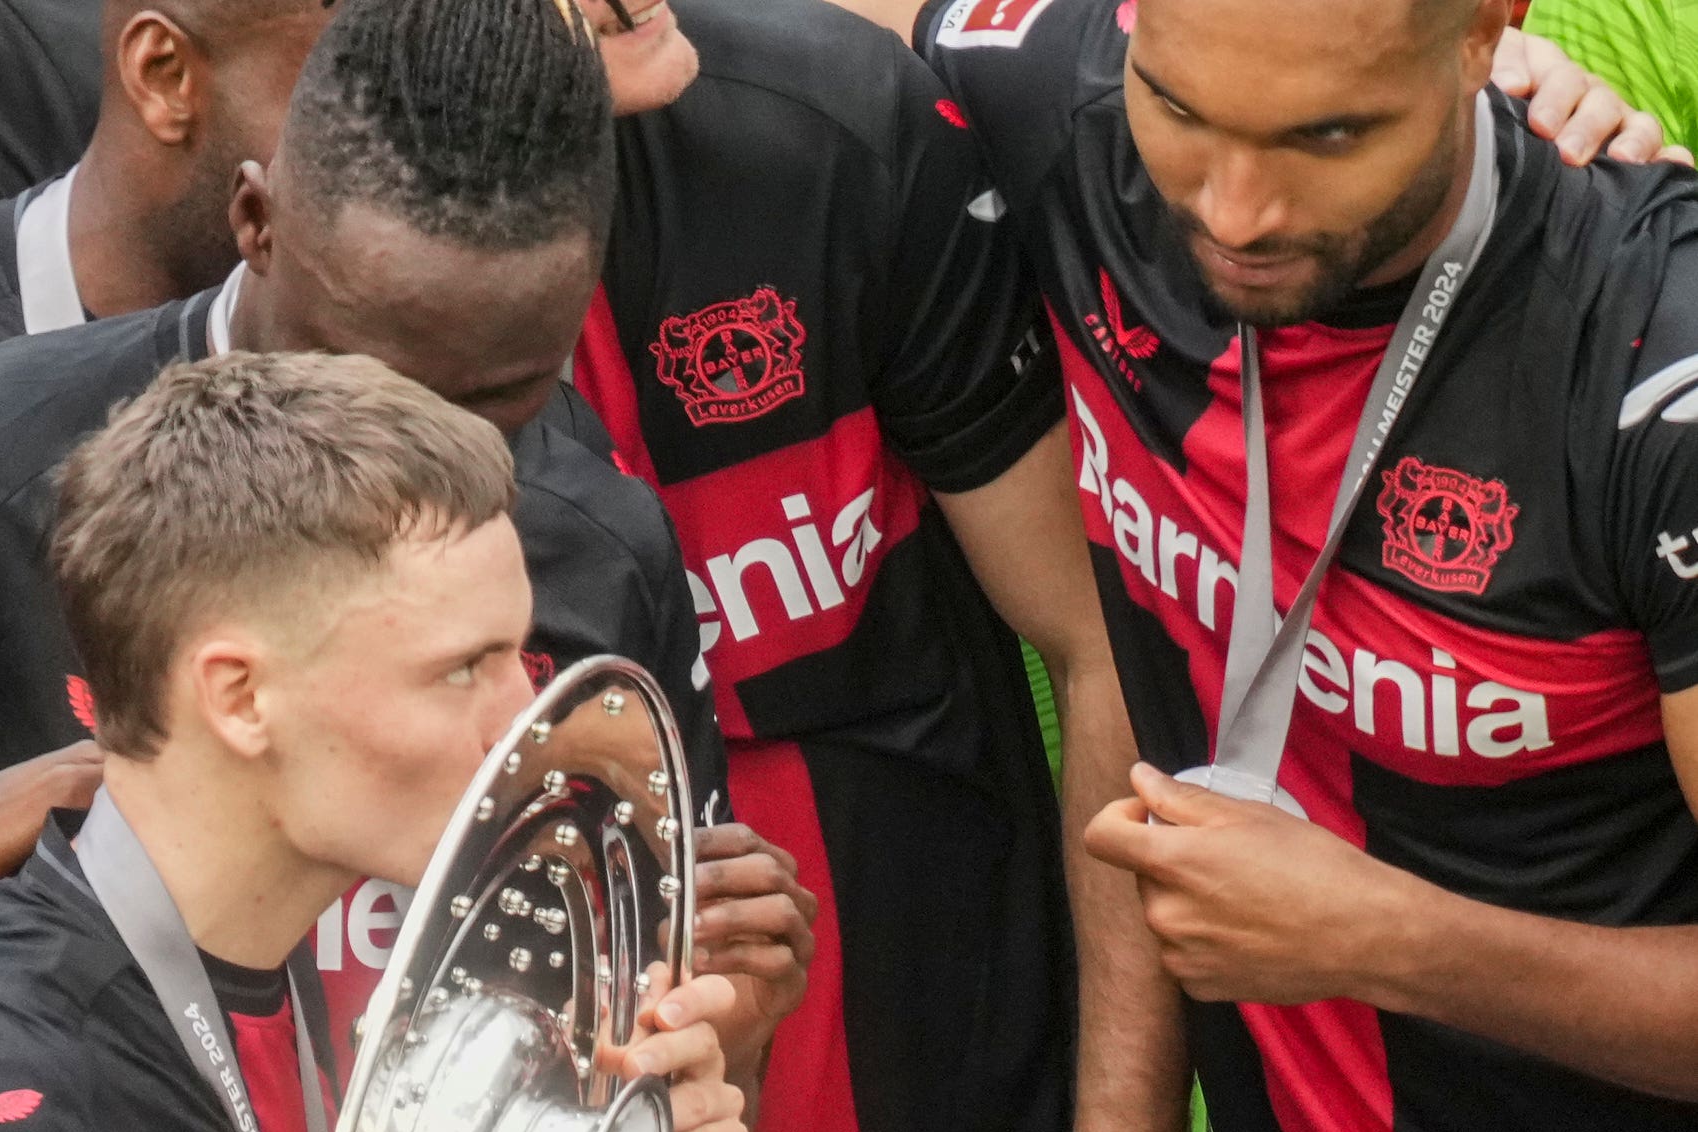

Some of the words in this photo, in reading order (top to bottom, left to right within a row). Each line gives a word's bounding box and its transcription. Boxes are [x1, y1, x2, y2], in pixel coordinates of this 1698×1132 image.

[1422, 260, 1464, 324] 2024
[704, 346, 765, 376] BAYER
[696, 379, 796, 417] Leverkusen
[183, 1001, 227, 1067] 2024
